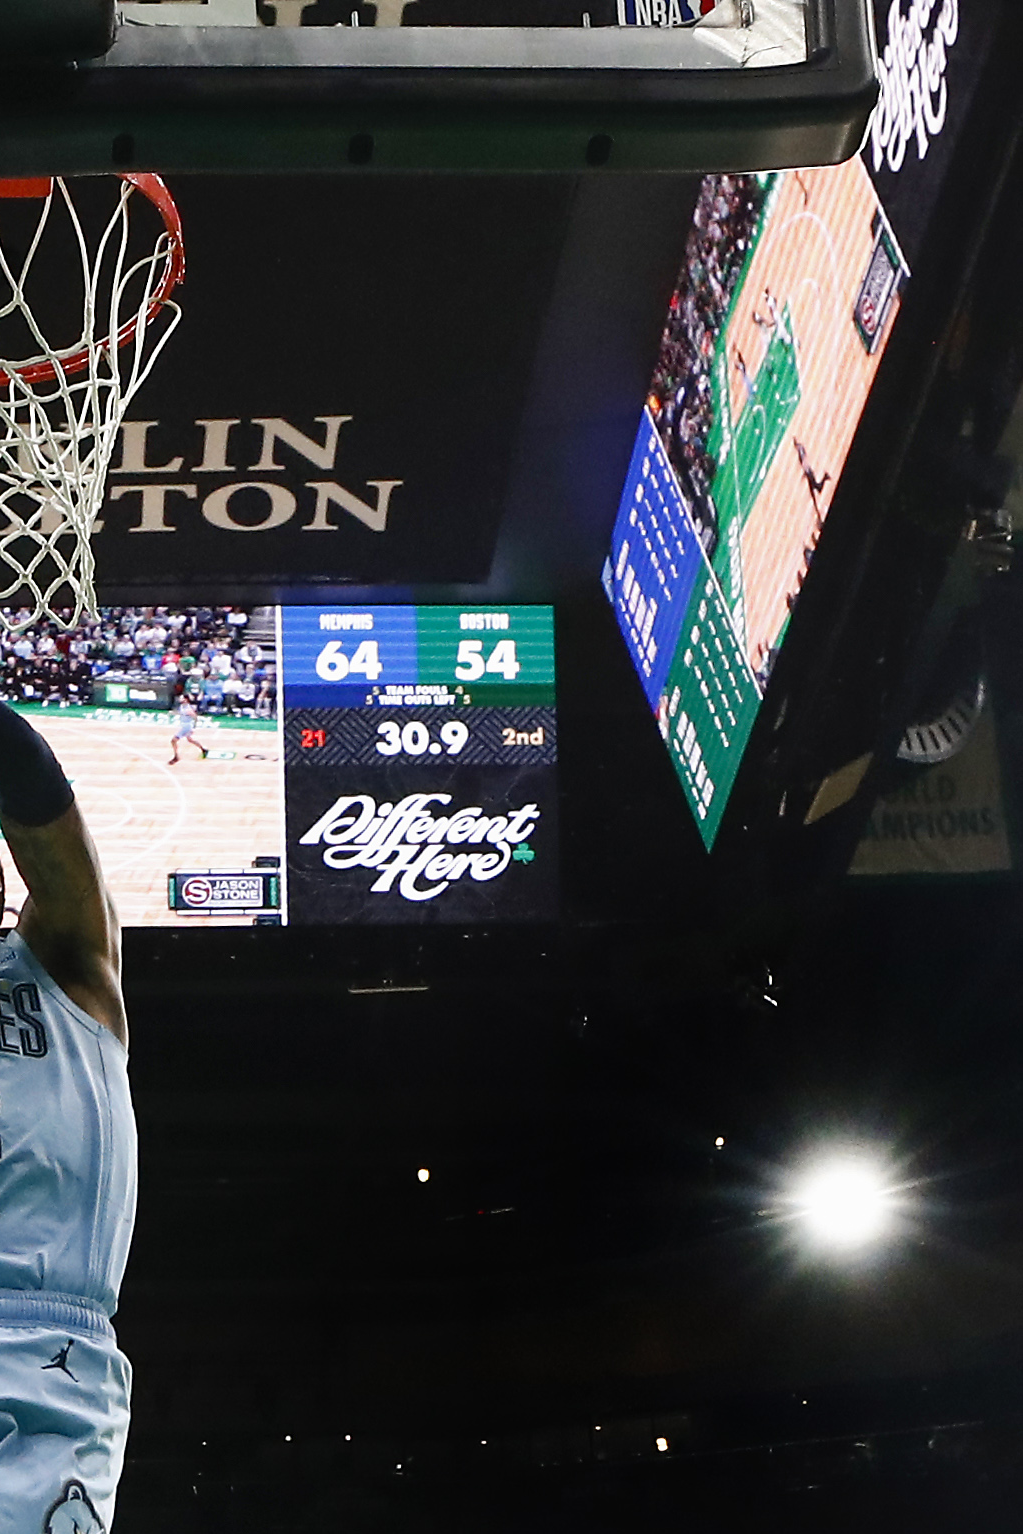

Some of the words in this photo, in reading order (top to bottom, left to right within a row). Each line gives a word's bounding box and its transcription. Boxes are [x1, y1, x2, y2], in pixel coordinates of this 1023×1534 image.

[319, 613, 374, 630] MEMPHIS
[459, 613, 510, 630] BOSTON
[315, 640, 383, 681] 64
[455, 640, 521, 681] 54
[385, 685, 414, 695] TEAM
[415, 685, 448, 695] FOULS
[378, 695, 403, 705] TIME
[433, 695, 456, 705] LEFT
[300, 728, 327, 748] 21
[375, 720, 470, 756] 30.9
[502, 727, 545, 746] 2nd
[299, 793, 540, 868] Different
[370, 840, 512, 901] Here
[212, 879, 259, 890] JASON
[212, 890, 259, 900] STONE
